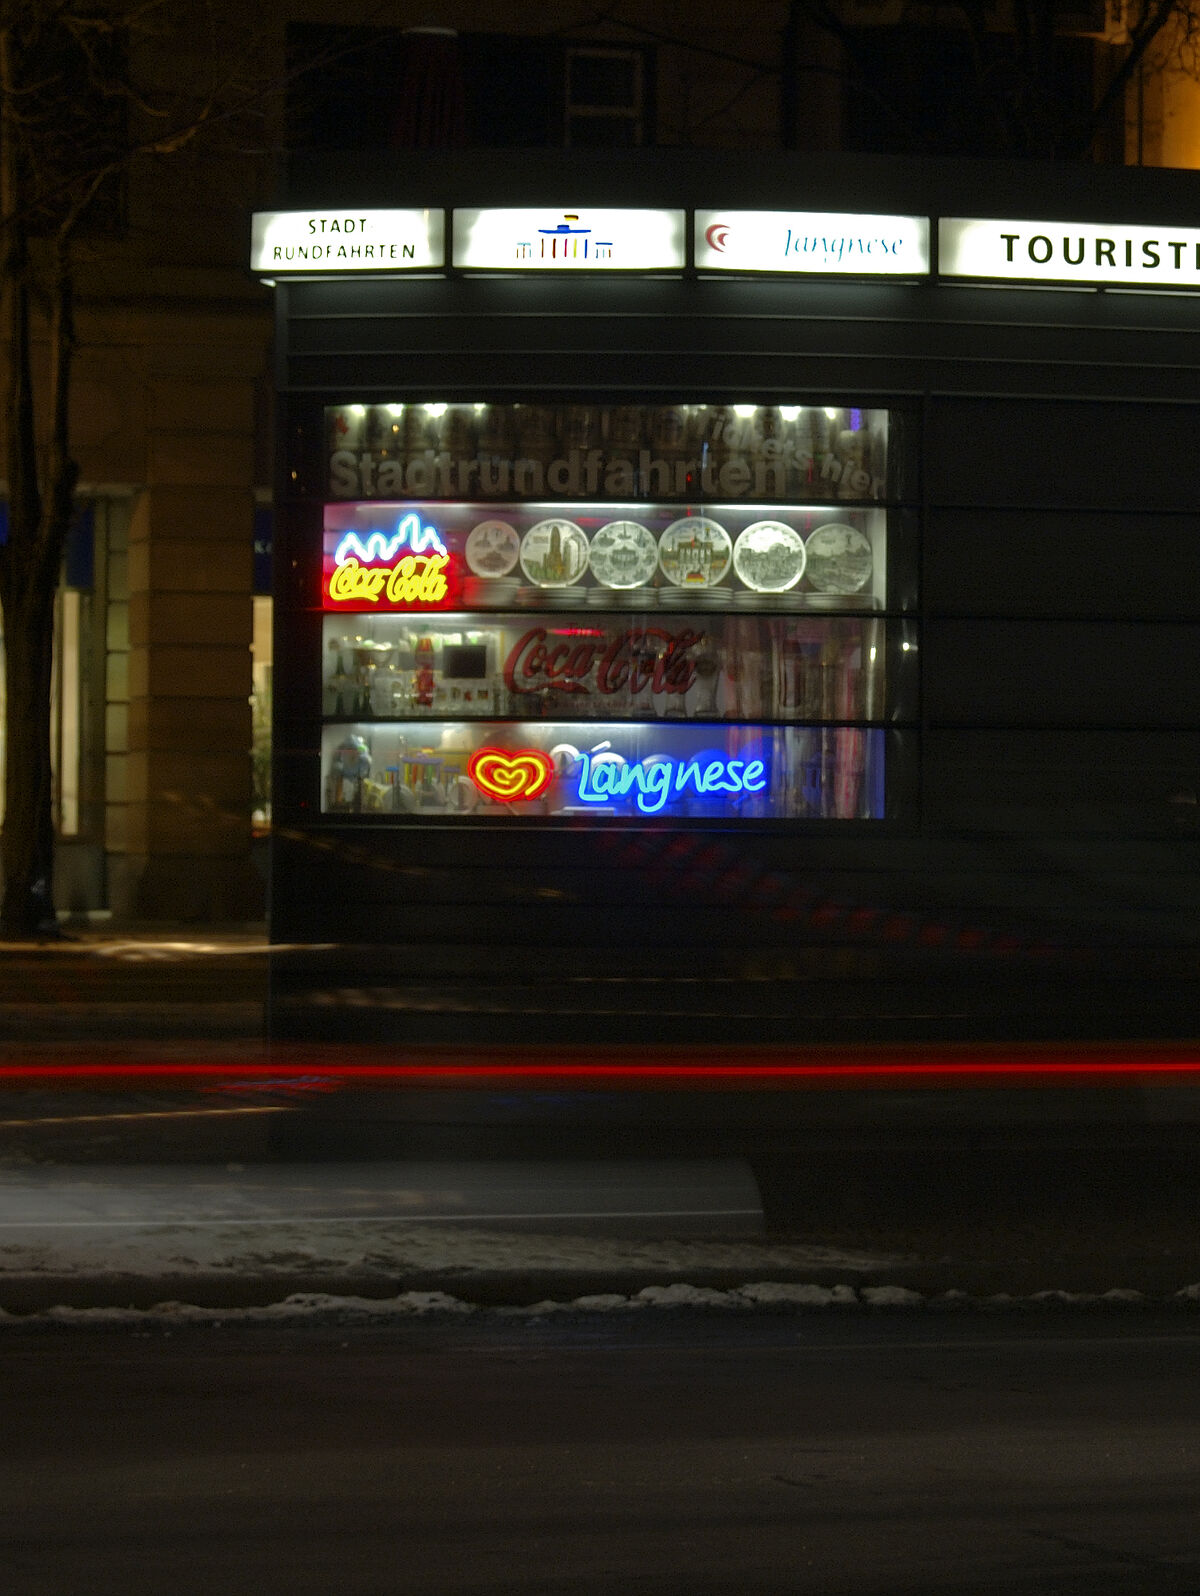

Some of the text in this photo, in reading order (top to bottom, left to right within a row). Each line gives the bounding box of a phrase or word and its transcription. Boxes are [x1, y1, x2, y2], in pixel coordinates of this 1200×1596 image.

[308, 219, 367, 235] STADT
[273, 244, 415, 261] RUNDFAHRTEN
[329, 449, 788, 497] Stadtrundfahrten
[574, 752, 767, 813] Langnese
